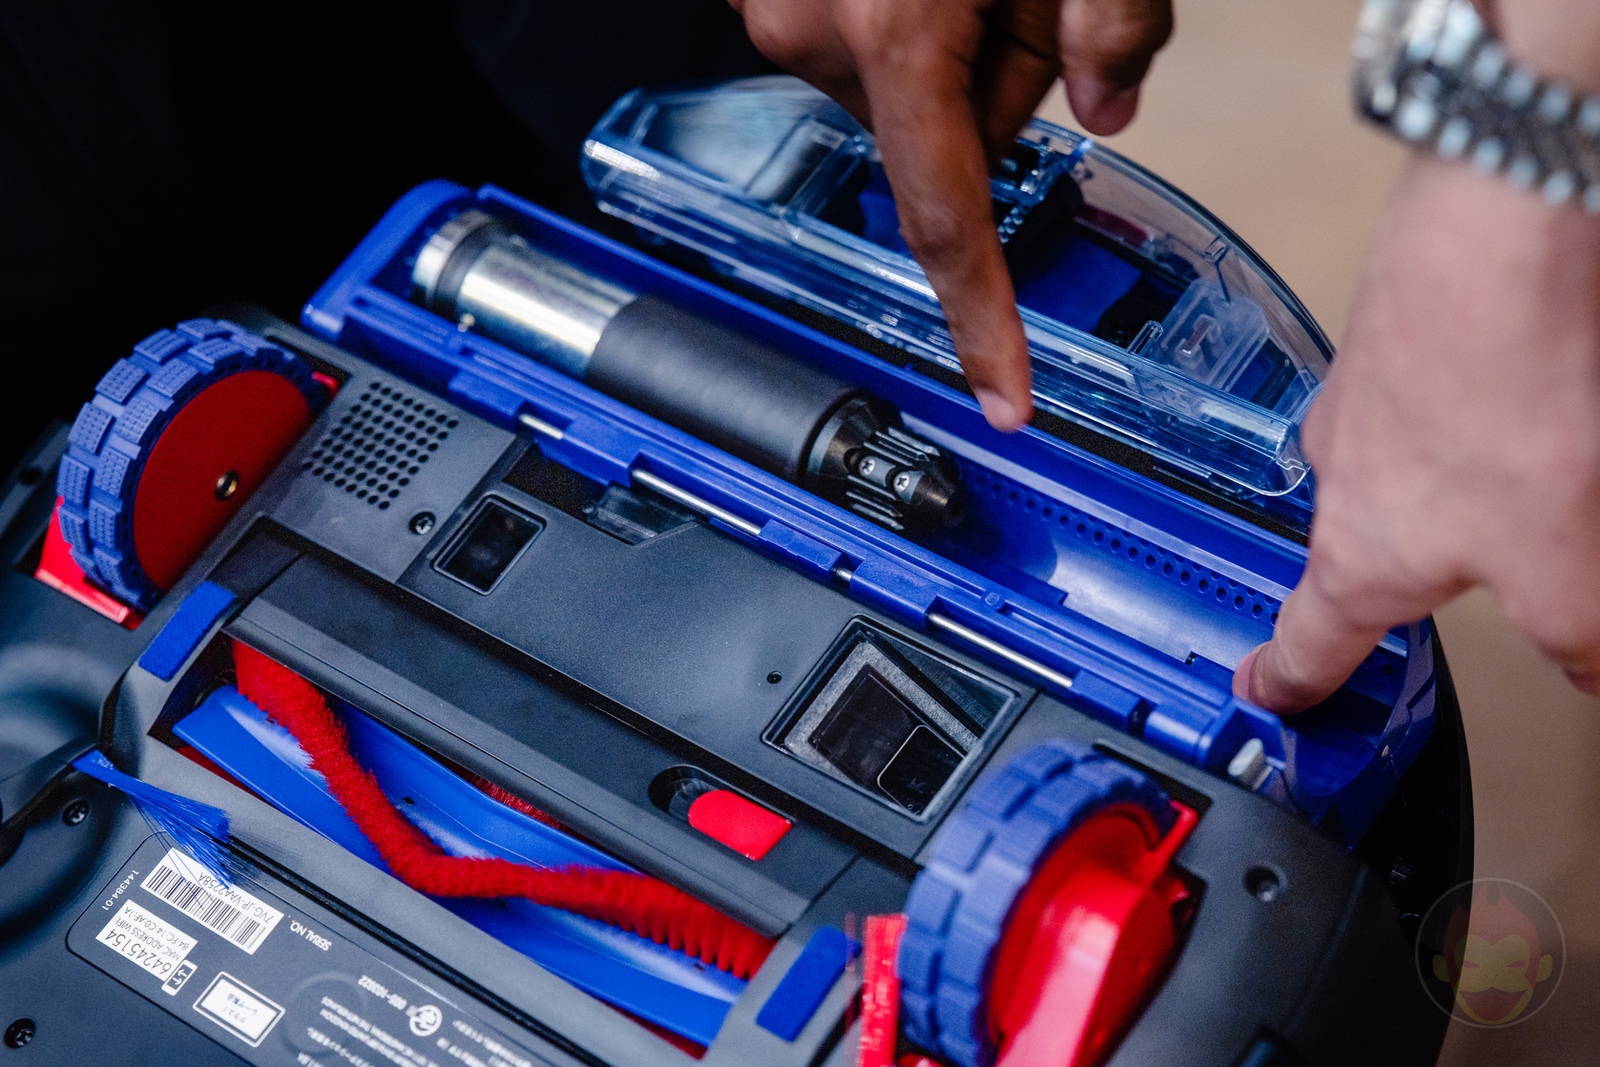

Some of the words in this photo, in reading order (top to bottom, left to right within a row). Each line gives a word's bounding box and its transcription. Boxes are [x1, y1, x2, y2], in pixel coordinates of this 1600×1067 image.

[101, 869, 139, 910] 144384-01
[114, 915, 132, 931] WIFI:
[289, 919, 307, 936] NO.
[129, 926, 164, 950] ADDRESS
[304, 929, 332, 951] SERIAL
[104, 928, 172, 975] 64245154
[160, 945, 182, 961] MAC
